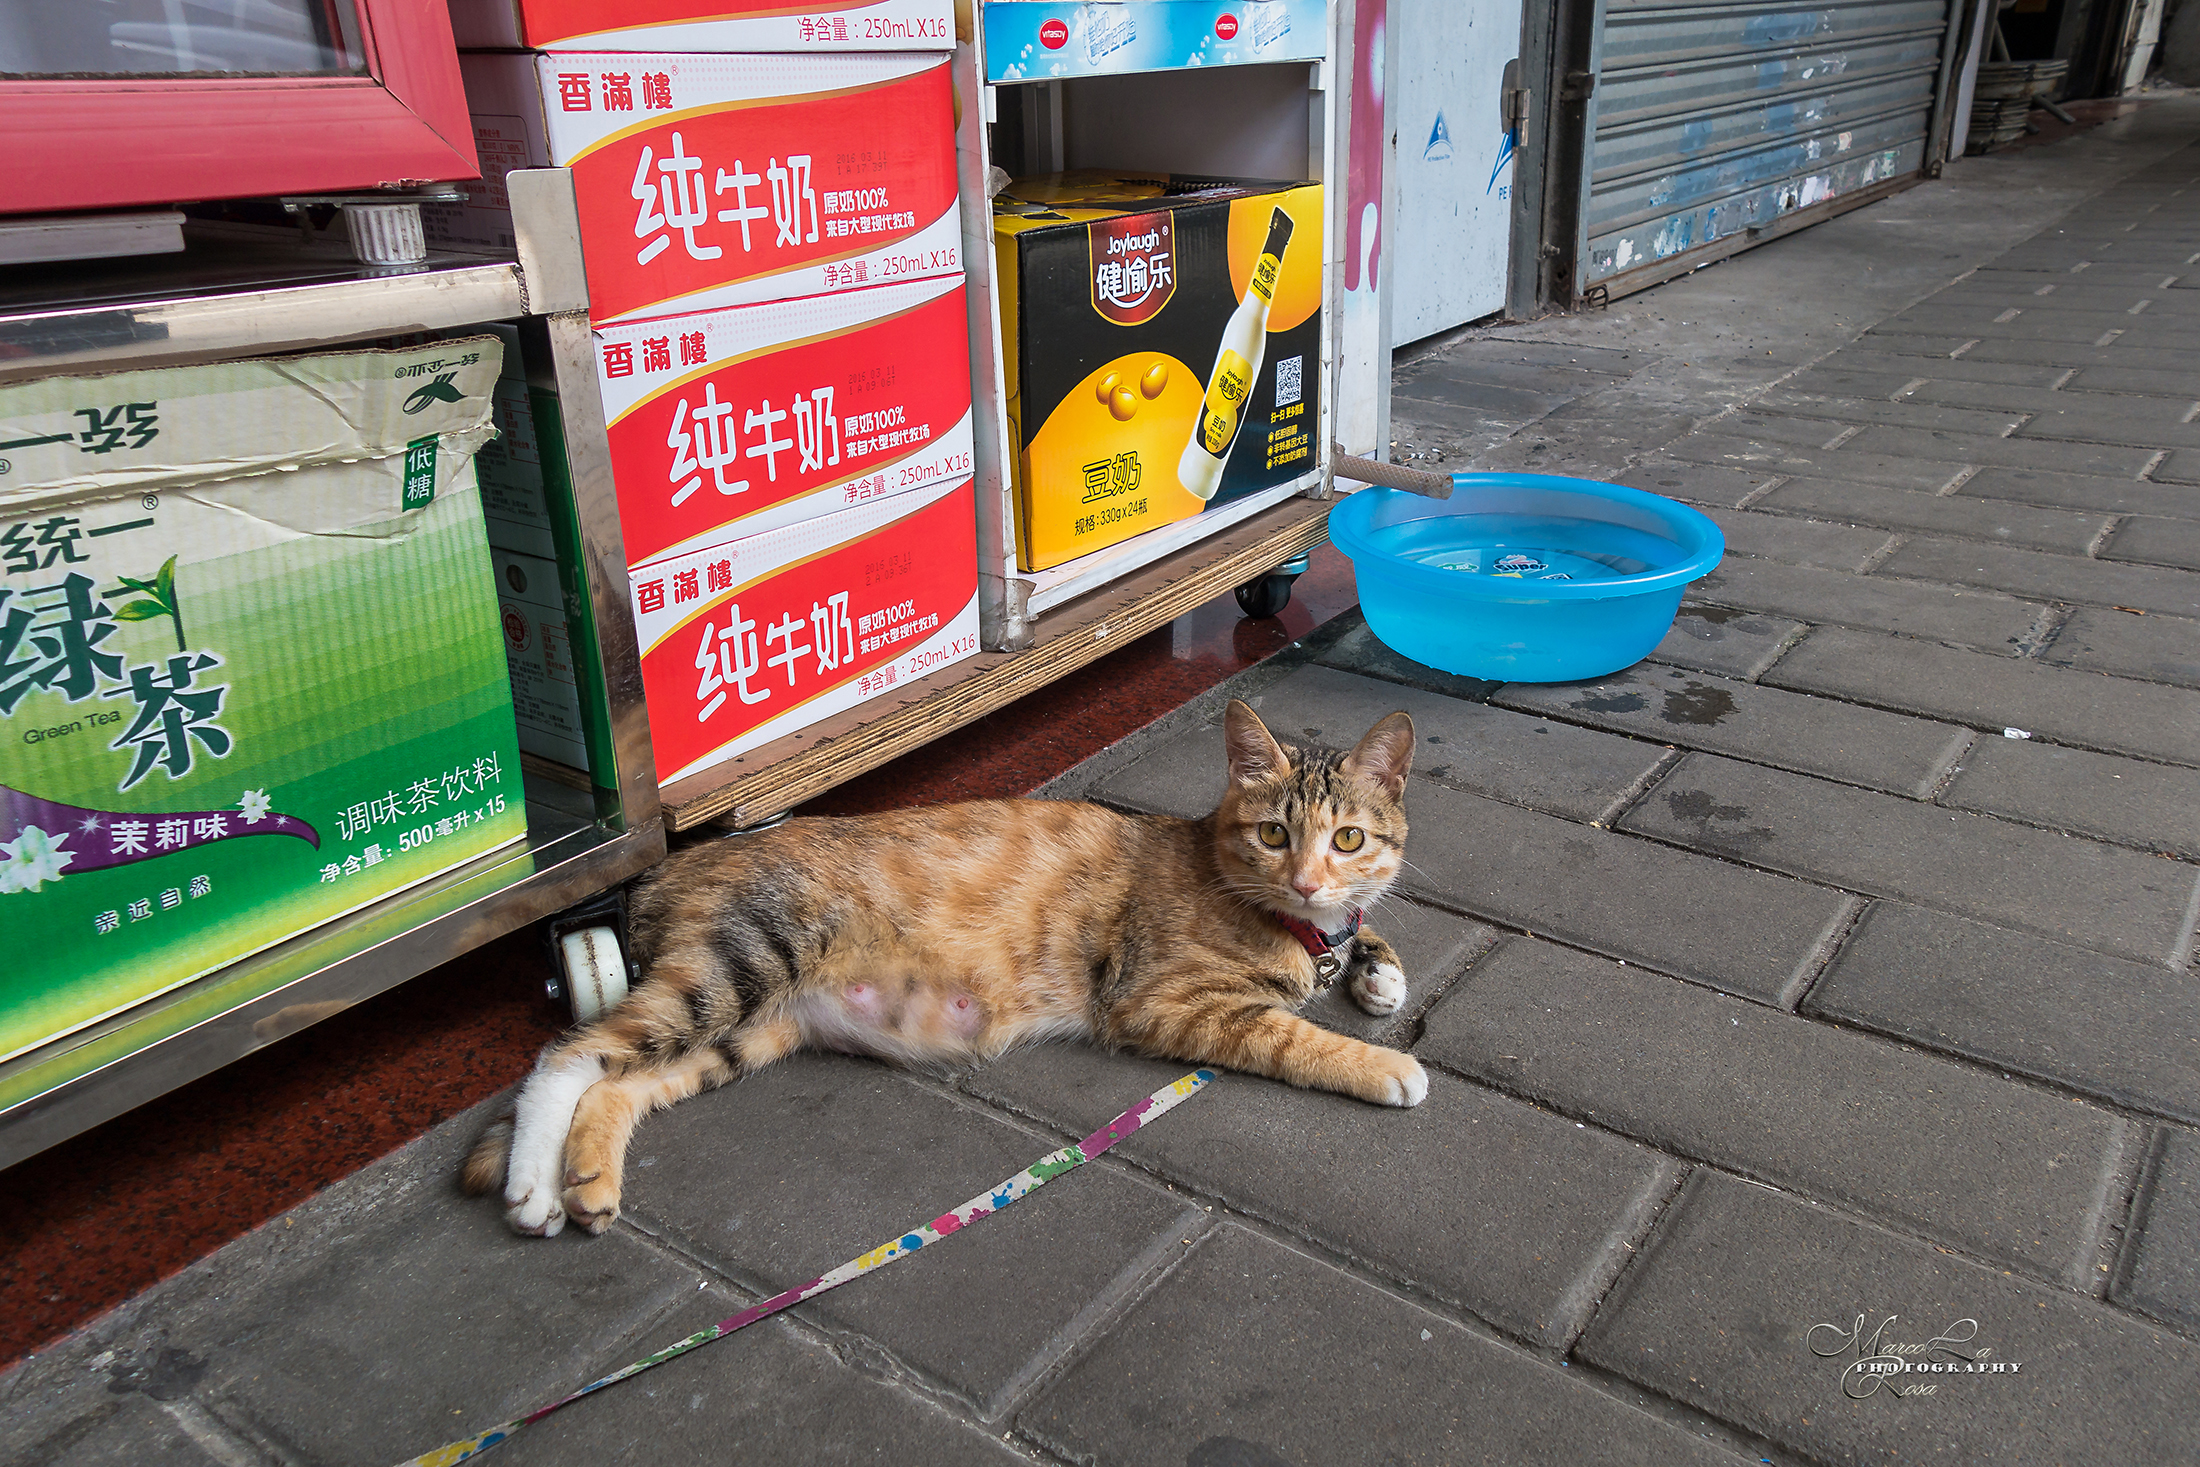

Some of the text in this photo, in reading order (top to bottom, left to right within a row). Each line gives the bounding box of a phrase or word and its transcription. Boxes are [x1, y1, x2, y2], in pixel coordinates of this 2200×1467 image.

[1042, 29, 1066, 40] vitasoy
[1215, 23, 1237, 32] vitasoy
[836, 150, 887, 164] 2016 03 11
[630, 131, 821, 265] 纯牛奶
[823, 187, 889, 215] 原奶100%
[825, 211, 915, 238] 来自大型现代牧场
[1106, 228, 1160, 257] Joylaugh
[1096, 252, 1172, 308] 健愉乐
[848, 365, 895, 384] 2016 03 11
[844, 405, 906, 438] 原奶100%
[667, 382, 841, 508] 纯牛奶
[846, 423, 930, 459] 来自大型现代牧场
[407, 445, 432, 502] 低糖
[1082, 451, 1141, 504] 豆奶
[2, 516, 155, 574] 统一
[865, 551, 911, 575] 2016 03 11
[858, 598, 915, 636] 原奶100%
[860, 613, 939, 656] 来自大型现代牧场
[694, 590, 855, 723] 纯牛奶
[23, 710, 122, 745] Green Tea
[335, 751, 502, 841] 调味茶饮料
[110, 813, 229, 855] 茉莉味
[94, 874, 212, 936] 亲近自然
